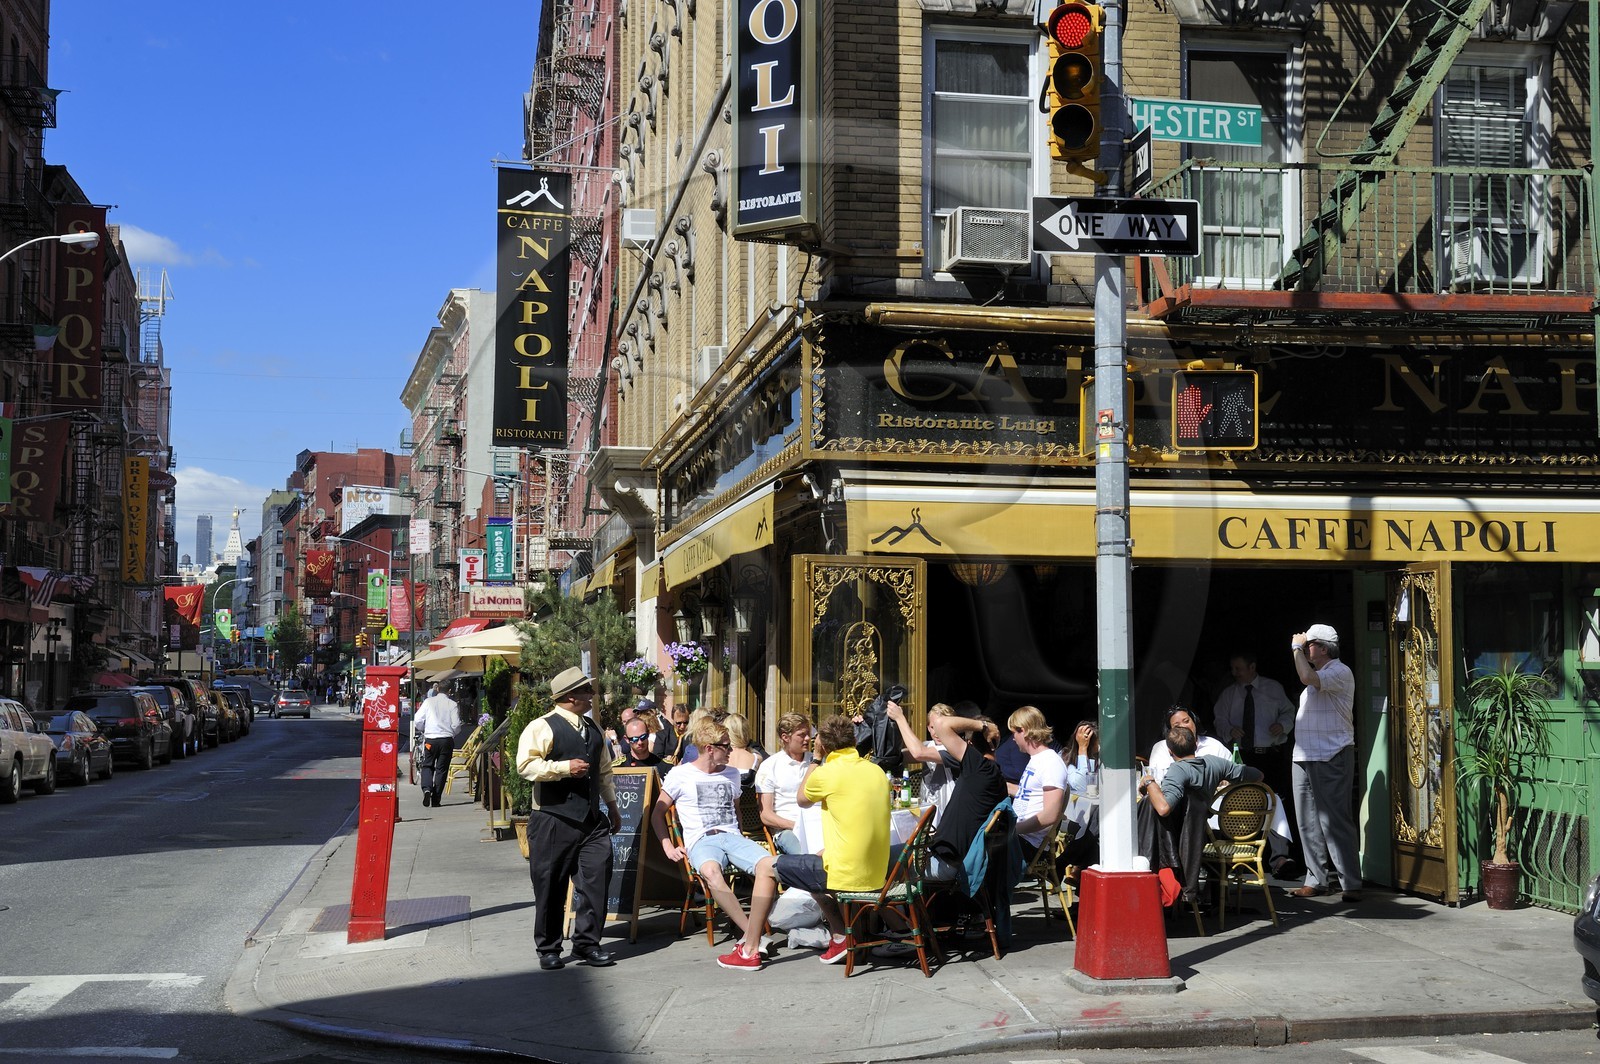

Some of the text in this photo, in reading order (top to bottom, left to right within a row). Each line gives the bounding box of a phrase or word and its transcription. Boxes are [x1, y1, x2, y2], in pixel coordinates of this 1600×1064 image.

[1133, 103, 1257, 140] HESTER ST
[739, 191, 802, 210] RISTORANTE
[506, 215, 563, 231] CAFFE
[1058, 214, 1177, 238] ONE WAY
[514, 235, 554, 423] NAPOLI
[495, 428, 564, 440] RISTORANTE
[877, 413, 1056, 434] Ristorante Luigi
[127, 461, 141, 582] BRICK OVEN PIZZA
[1217, 515, 1559, 553] CAFFE NAPOLI
[494, 531, 504, 573] PAESANO'S
[473, 595, 522, 605] La Nonna
